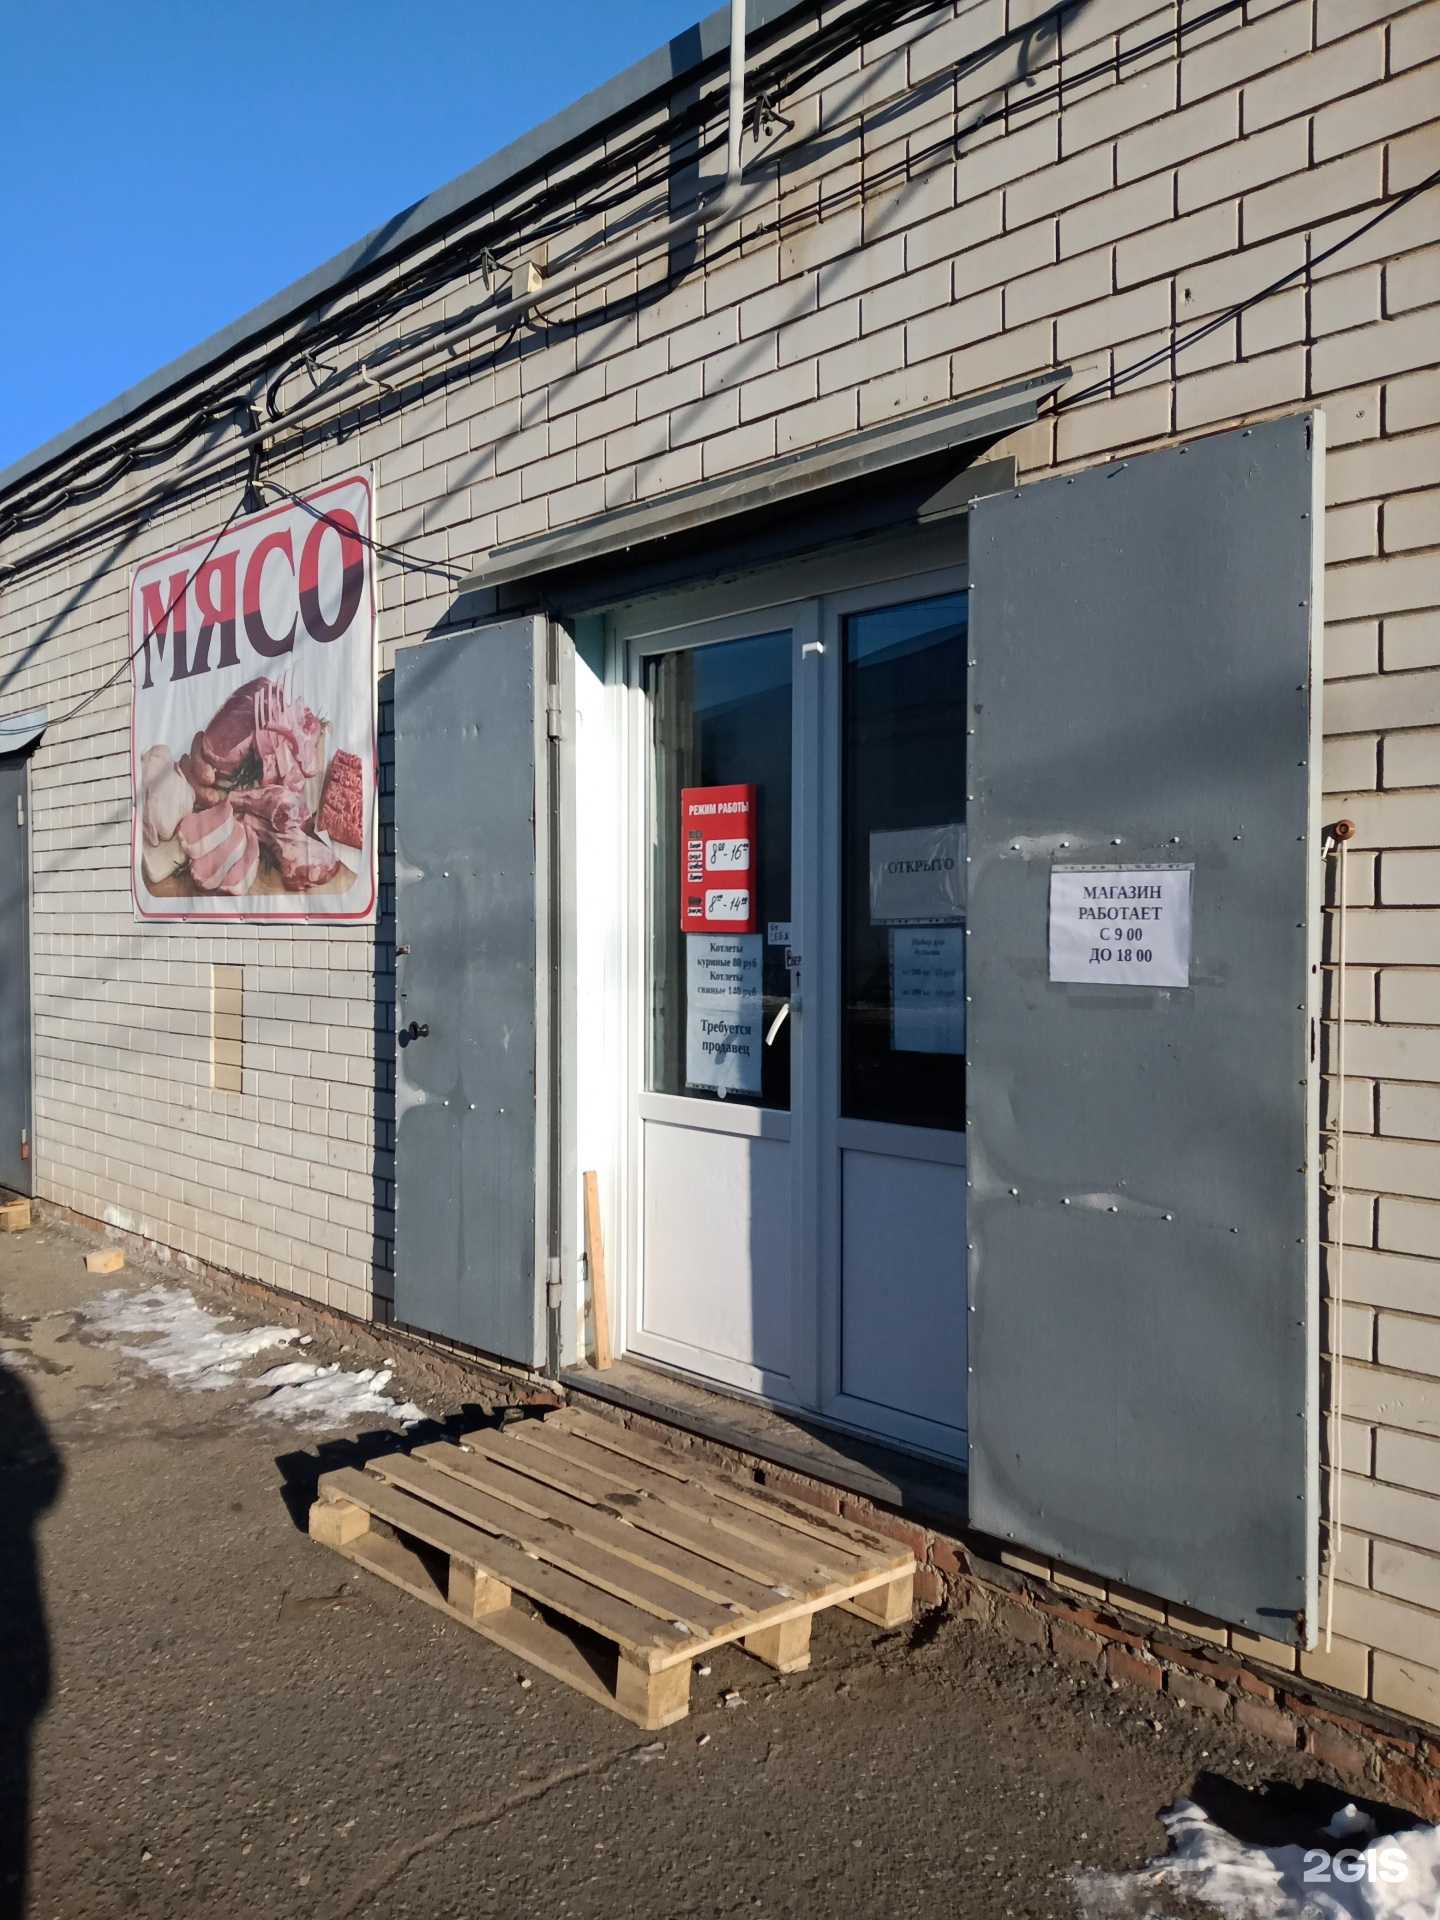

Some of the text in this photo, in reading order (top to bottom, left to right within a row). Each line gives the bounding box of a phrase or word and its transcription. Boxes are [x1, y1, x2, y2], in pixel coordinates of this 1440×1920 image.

[140, 508, 364, 689] МЯСО
[688, 801, 750, 816] РЕЖИМ РАБОТЫ
[888, 857, 955, 874] ОТКРЫТО
[1082, 885, 1162, 899] МАГАЗИН
[1078, 906, 1163, 920] РАБОТАЕТ
[1099, 928, 1143, 941] С 9 00
[710, 943, 743, 952] Котлеты
[1088, 948, 1153, 964] ДО 18 00
[710, 971, 743, 981] Котлеты
[701, 1018, 752, 1036] Требуется
[702, 1041, 751, 1057] продавец
